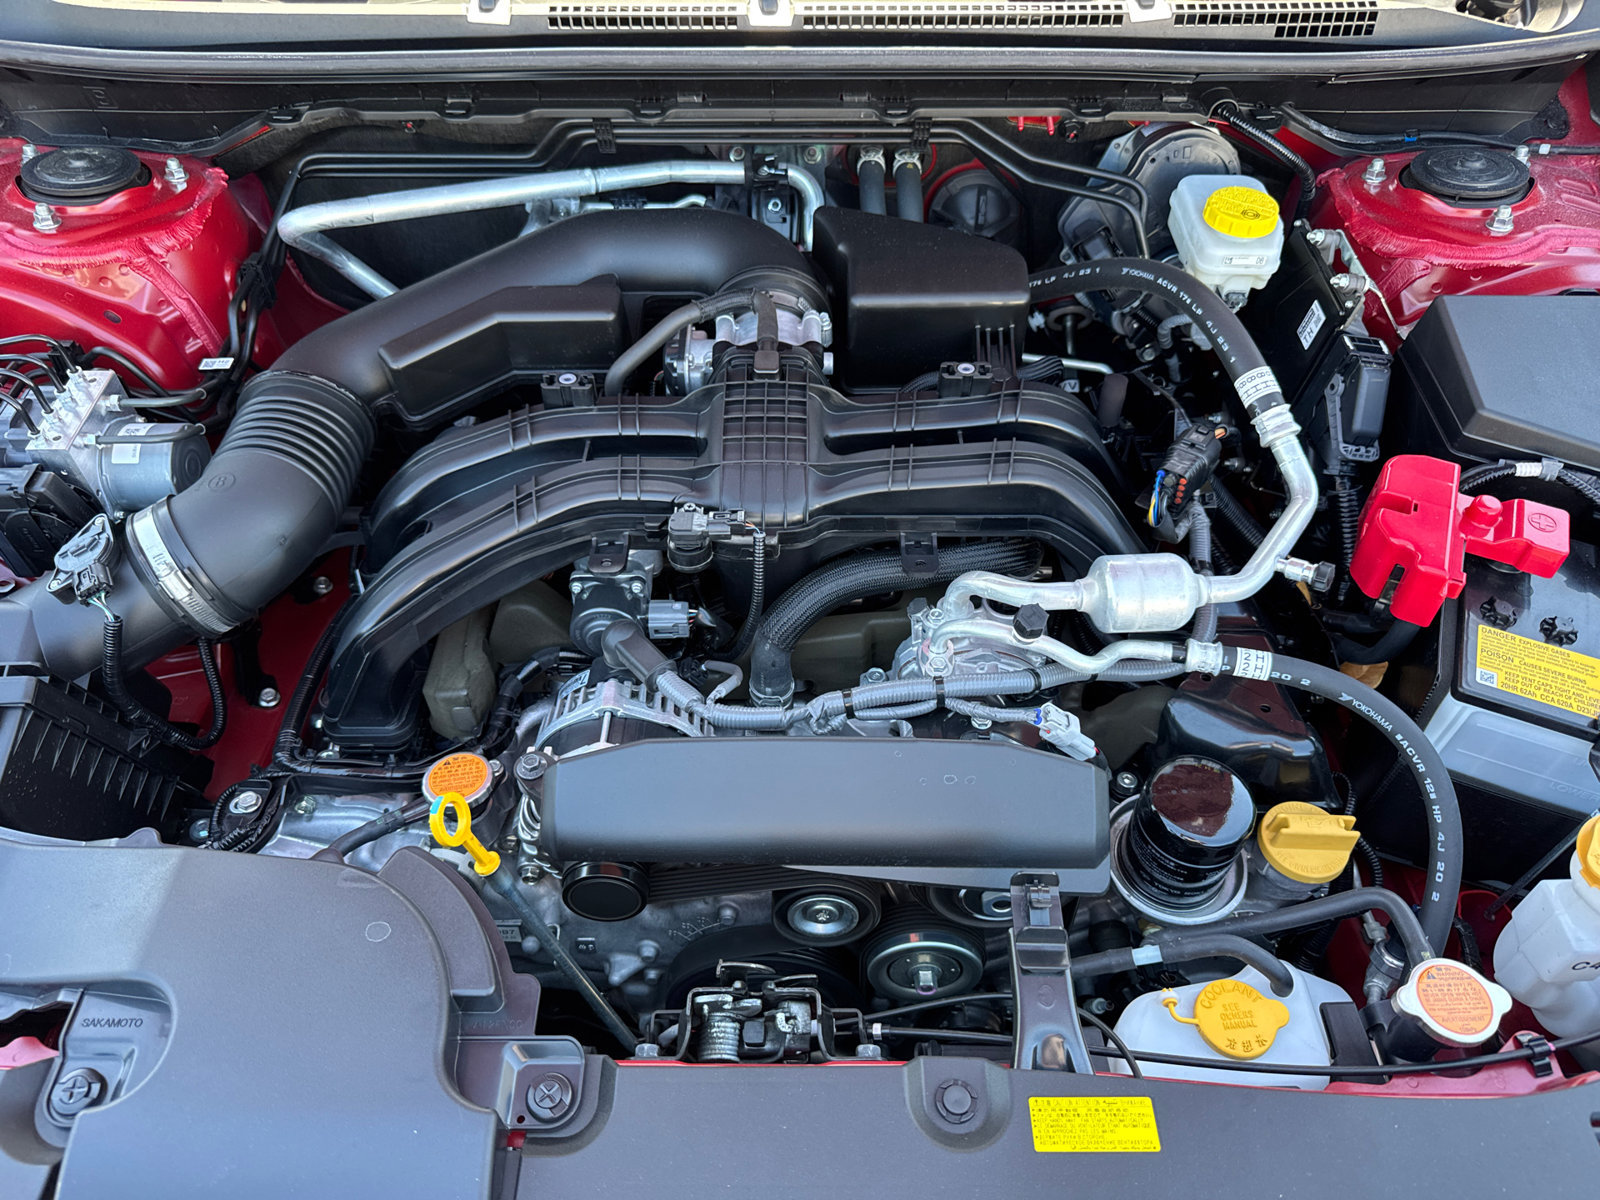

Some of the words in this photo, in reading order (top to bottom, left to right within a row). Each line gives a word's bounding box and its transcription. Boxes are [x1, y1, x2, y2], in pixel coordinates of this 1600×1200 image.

[1156, 277, 1178, 294] ACVR
[1481, 627, 1516, 642] DANGER
[1519, 639, 1550, 653] EXPLOSIVE
[1551, 646, 1571, 658] GASES
[1481, 648, 1514, 663] POISON
[1519, 660, 1542, 671] CAUSES
[1543, 667, 1567, 679] SEVERE
[1567, 674, 1587, 685] BURNS
[1271, 671, 1292, 681] 20
[1299, 678, 1311, 686] 2
[1504, 671, 1520, 679] KEEP
[1521, 675, 1536, 684] VENT
[1537, 681, 1553, 689] CAPS
[1554, 685, 1571, 695] TIGHT
[1572, 690, 1584, 699] AND
[1585, 695, 1600, 704] LEVE
[1501, 681, 1519, 693] 20HR
[1520, 688, 1537, 698] 62Ah
[1540, 694, 1556, 705] CCA
[1556, 699, 1574, 710] 620A
[1504, 677, 1520, 685] KEEP
[1520, 681, 1533, 689] OUT
[1543, 688, 1563, 698] REACH
[1573, 697, 1600, 709] CHILDRE
[1351, 699, 1393, 732] YOKOHAMA
[1399, 740, 1426, 773] ACVR
[1432, 805, 1442, 824] HP
[1437, 831, 1445, 852] 4J
[1435, 861, 1445, 883] 20
[1431, 891, 1440, 902] 2
[1200, 982, 1264, 1009] COOLANT
[1220, 1010, 1254, 1021] OWNERS
[1222, 1002, 1240, 1012] SEE
[81, 1017, 144, 1028] SAKAMOTO
[1222, 1020, 1259, 1031] MANUAL
